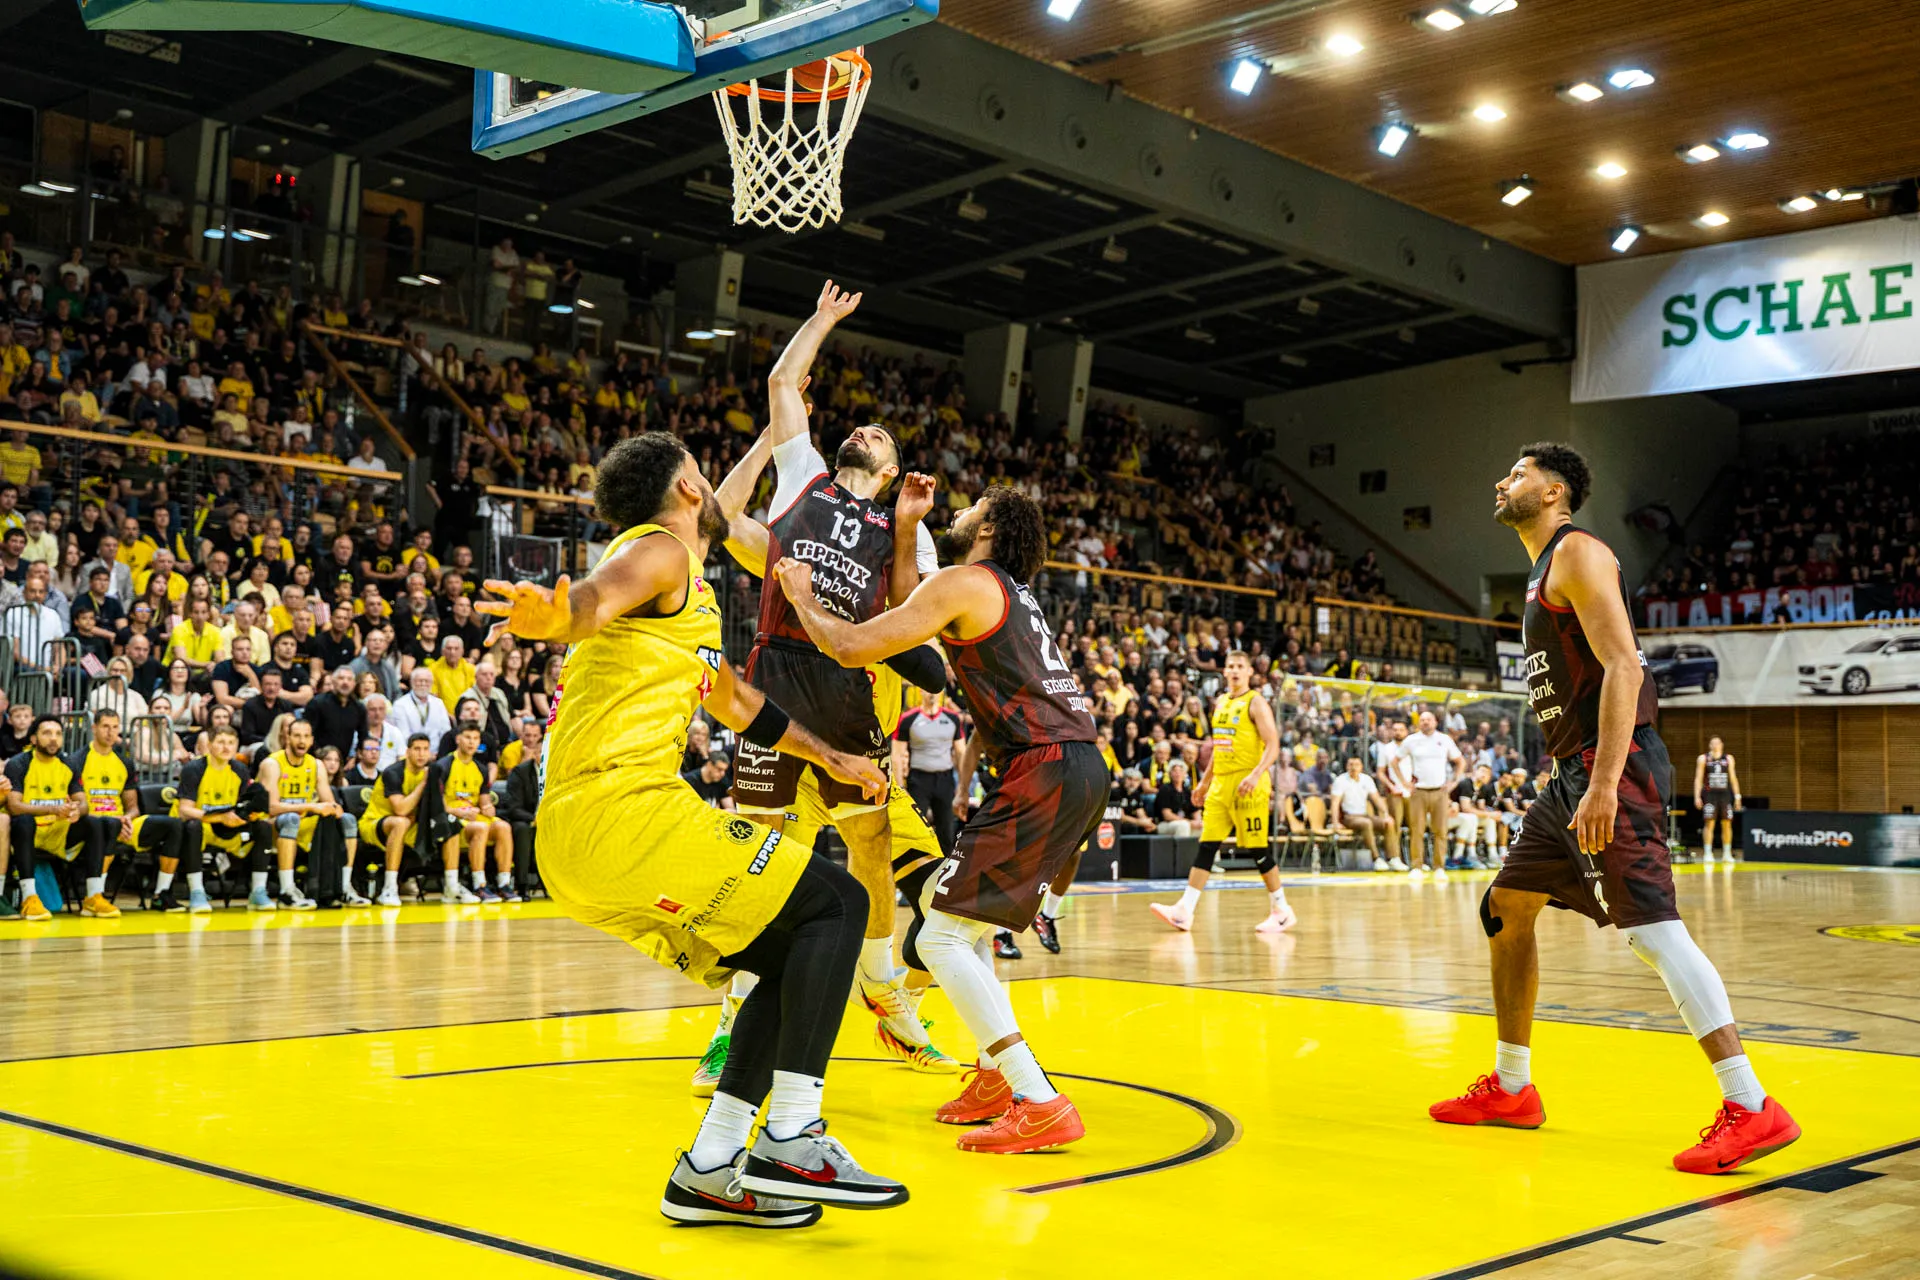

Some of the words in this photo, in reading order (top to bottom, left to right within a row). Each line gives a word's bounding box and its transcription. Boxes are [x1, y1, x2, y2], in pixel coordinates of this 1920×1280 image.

[1662, 263, 1913, 348] SCHAE
[830, 511, 863, 550] 13
[1245, 817, 1262, 832] 10
[1750, 828, 1854, 849] TippmixPRO
[1110, 860, 1119, 880] 1
